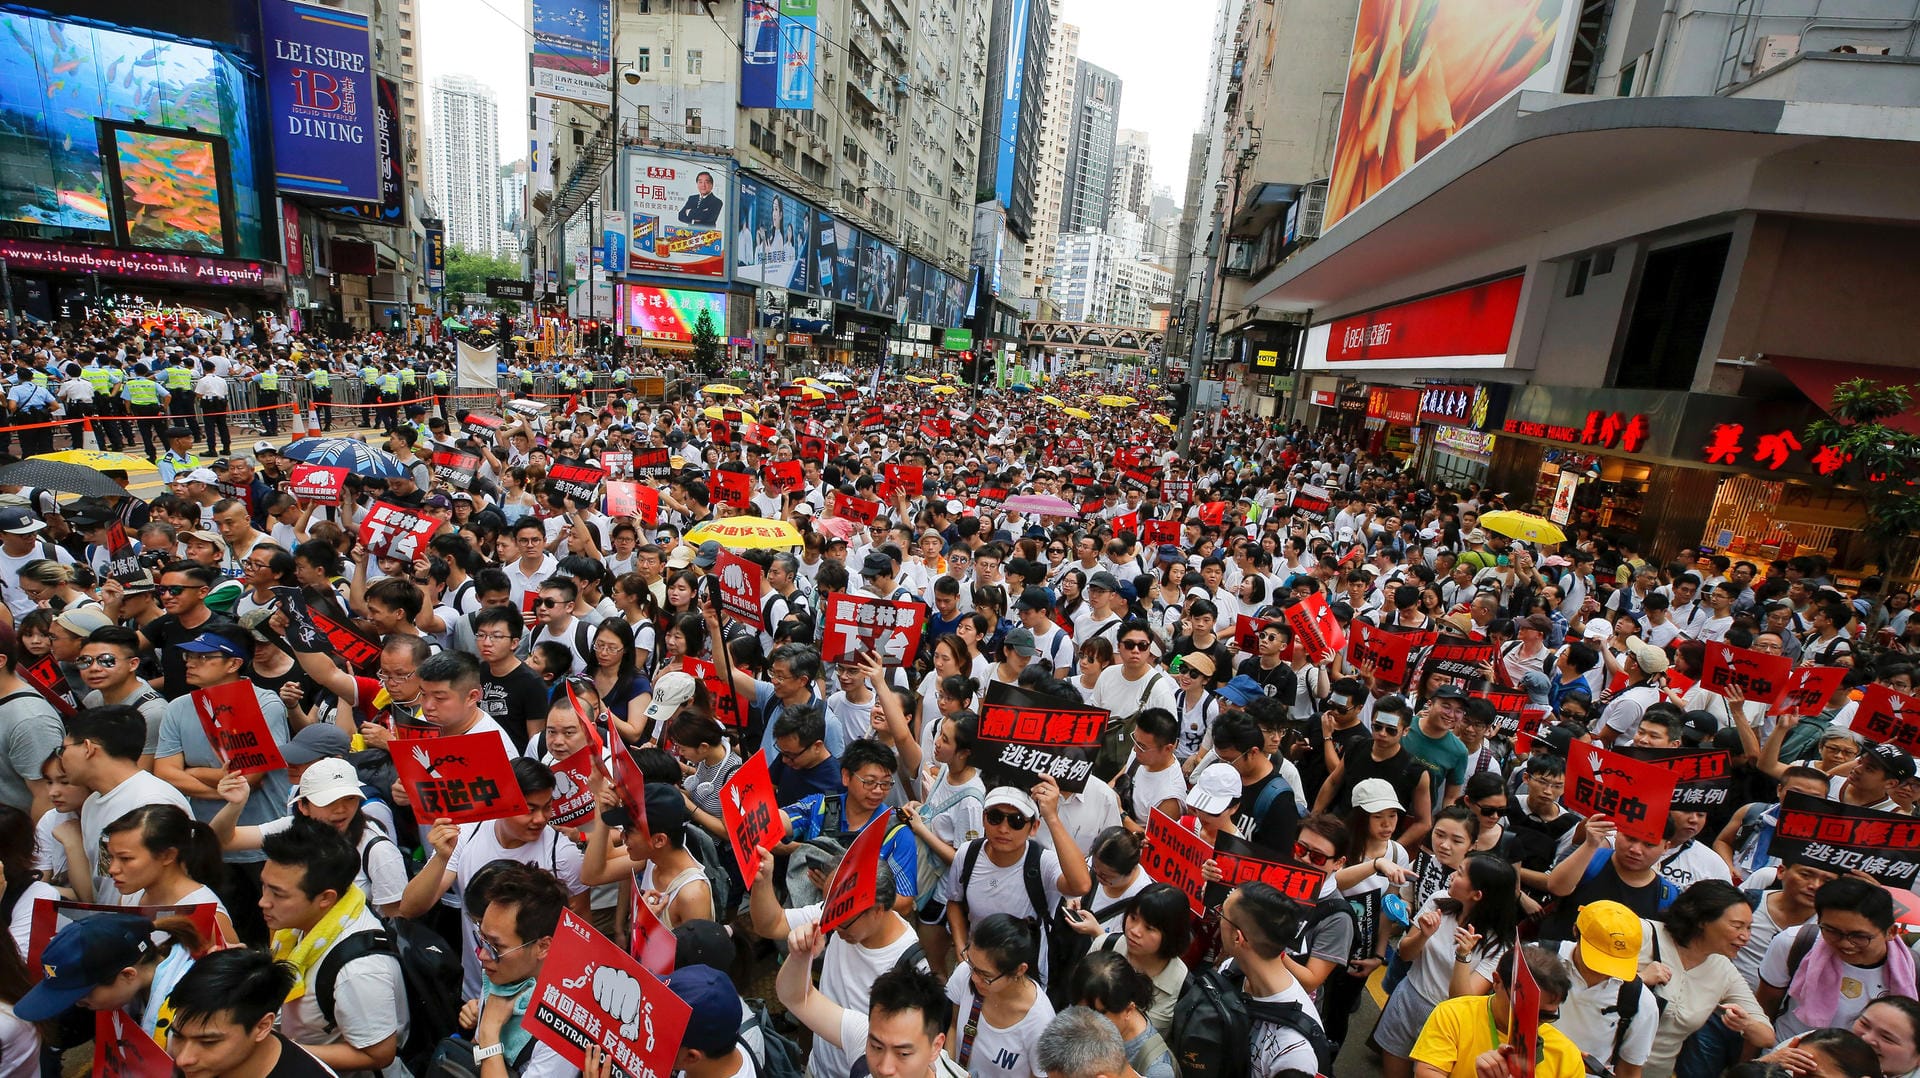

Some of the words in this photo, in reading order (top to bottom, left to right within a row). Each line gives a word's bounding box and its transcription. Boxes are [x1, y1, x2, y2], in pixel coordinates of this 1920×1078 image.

[275, 39, 365, 73] LEISURE
[1014, 58, 1022, 101] 3602
[288, 115, 364, 144] DINING
[1009, 111, 1017, 154] 2388
[635, 184, 667, 201] 中風
[8, 249, 188, 274] www.islandbeverley.com.hk
[198, 266, 214, 277] Ad
[216, 268, 262, 281] Enquiry:
[1348, 327, 1365, 349] BEA
[1504, 419, 1518, 434] BEE
[1519, 422, 1545, 438] CHENG
[1547, 425, 1575, 442] HIANG
[1580, 410, 1649, 453] 美珍香
[713, 486, 742, 502] 反送中
[368, 520, 418, 563] 下台
[836, 600, 916, 628] 賣港林鄭
[834, 623, 910, 667] 下台
[1353, 643, 1394, 672] 反送中
[1712, 666, 1772, 695] 反送中
[219, 729, 259, 751] China
[981, 708, 1105, 743] 撤回修訂
[228, 751, 268, 770] adition
[998, 743, 1093, 782] 逃犯條例
[415, 776, 501, 813] 反送中
[558, 790, 594, 814] 反對送
[1575, 776, 1648, 823] 反送中
[574, 808, 585, 818] TO
[1782, 811, 1920, 847] 撤回修訂
[736, 800, 771, 864] 反送中
[1148, 821, 1159, 837] No
[1160, 827, 1203, 868] Extraditi
[1146, 843, 1161, 869] To
[1164, 857, 1203, 902] China
[1801, 842, 1919, 879] 逃犯條例
[542, 983, 602, 1040] 撤回惡法
[538, 1006, 553, 1024] NO
[611, 1063, 623, 1078] TO
[992, 1047, 1020, 1070] JW
